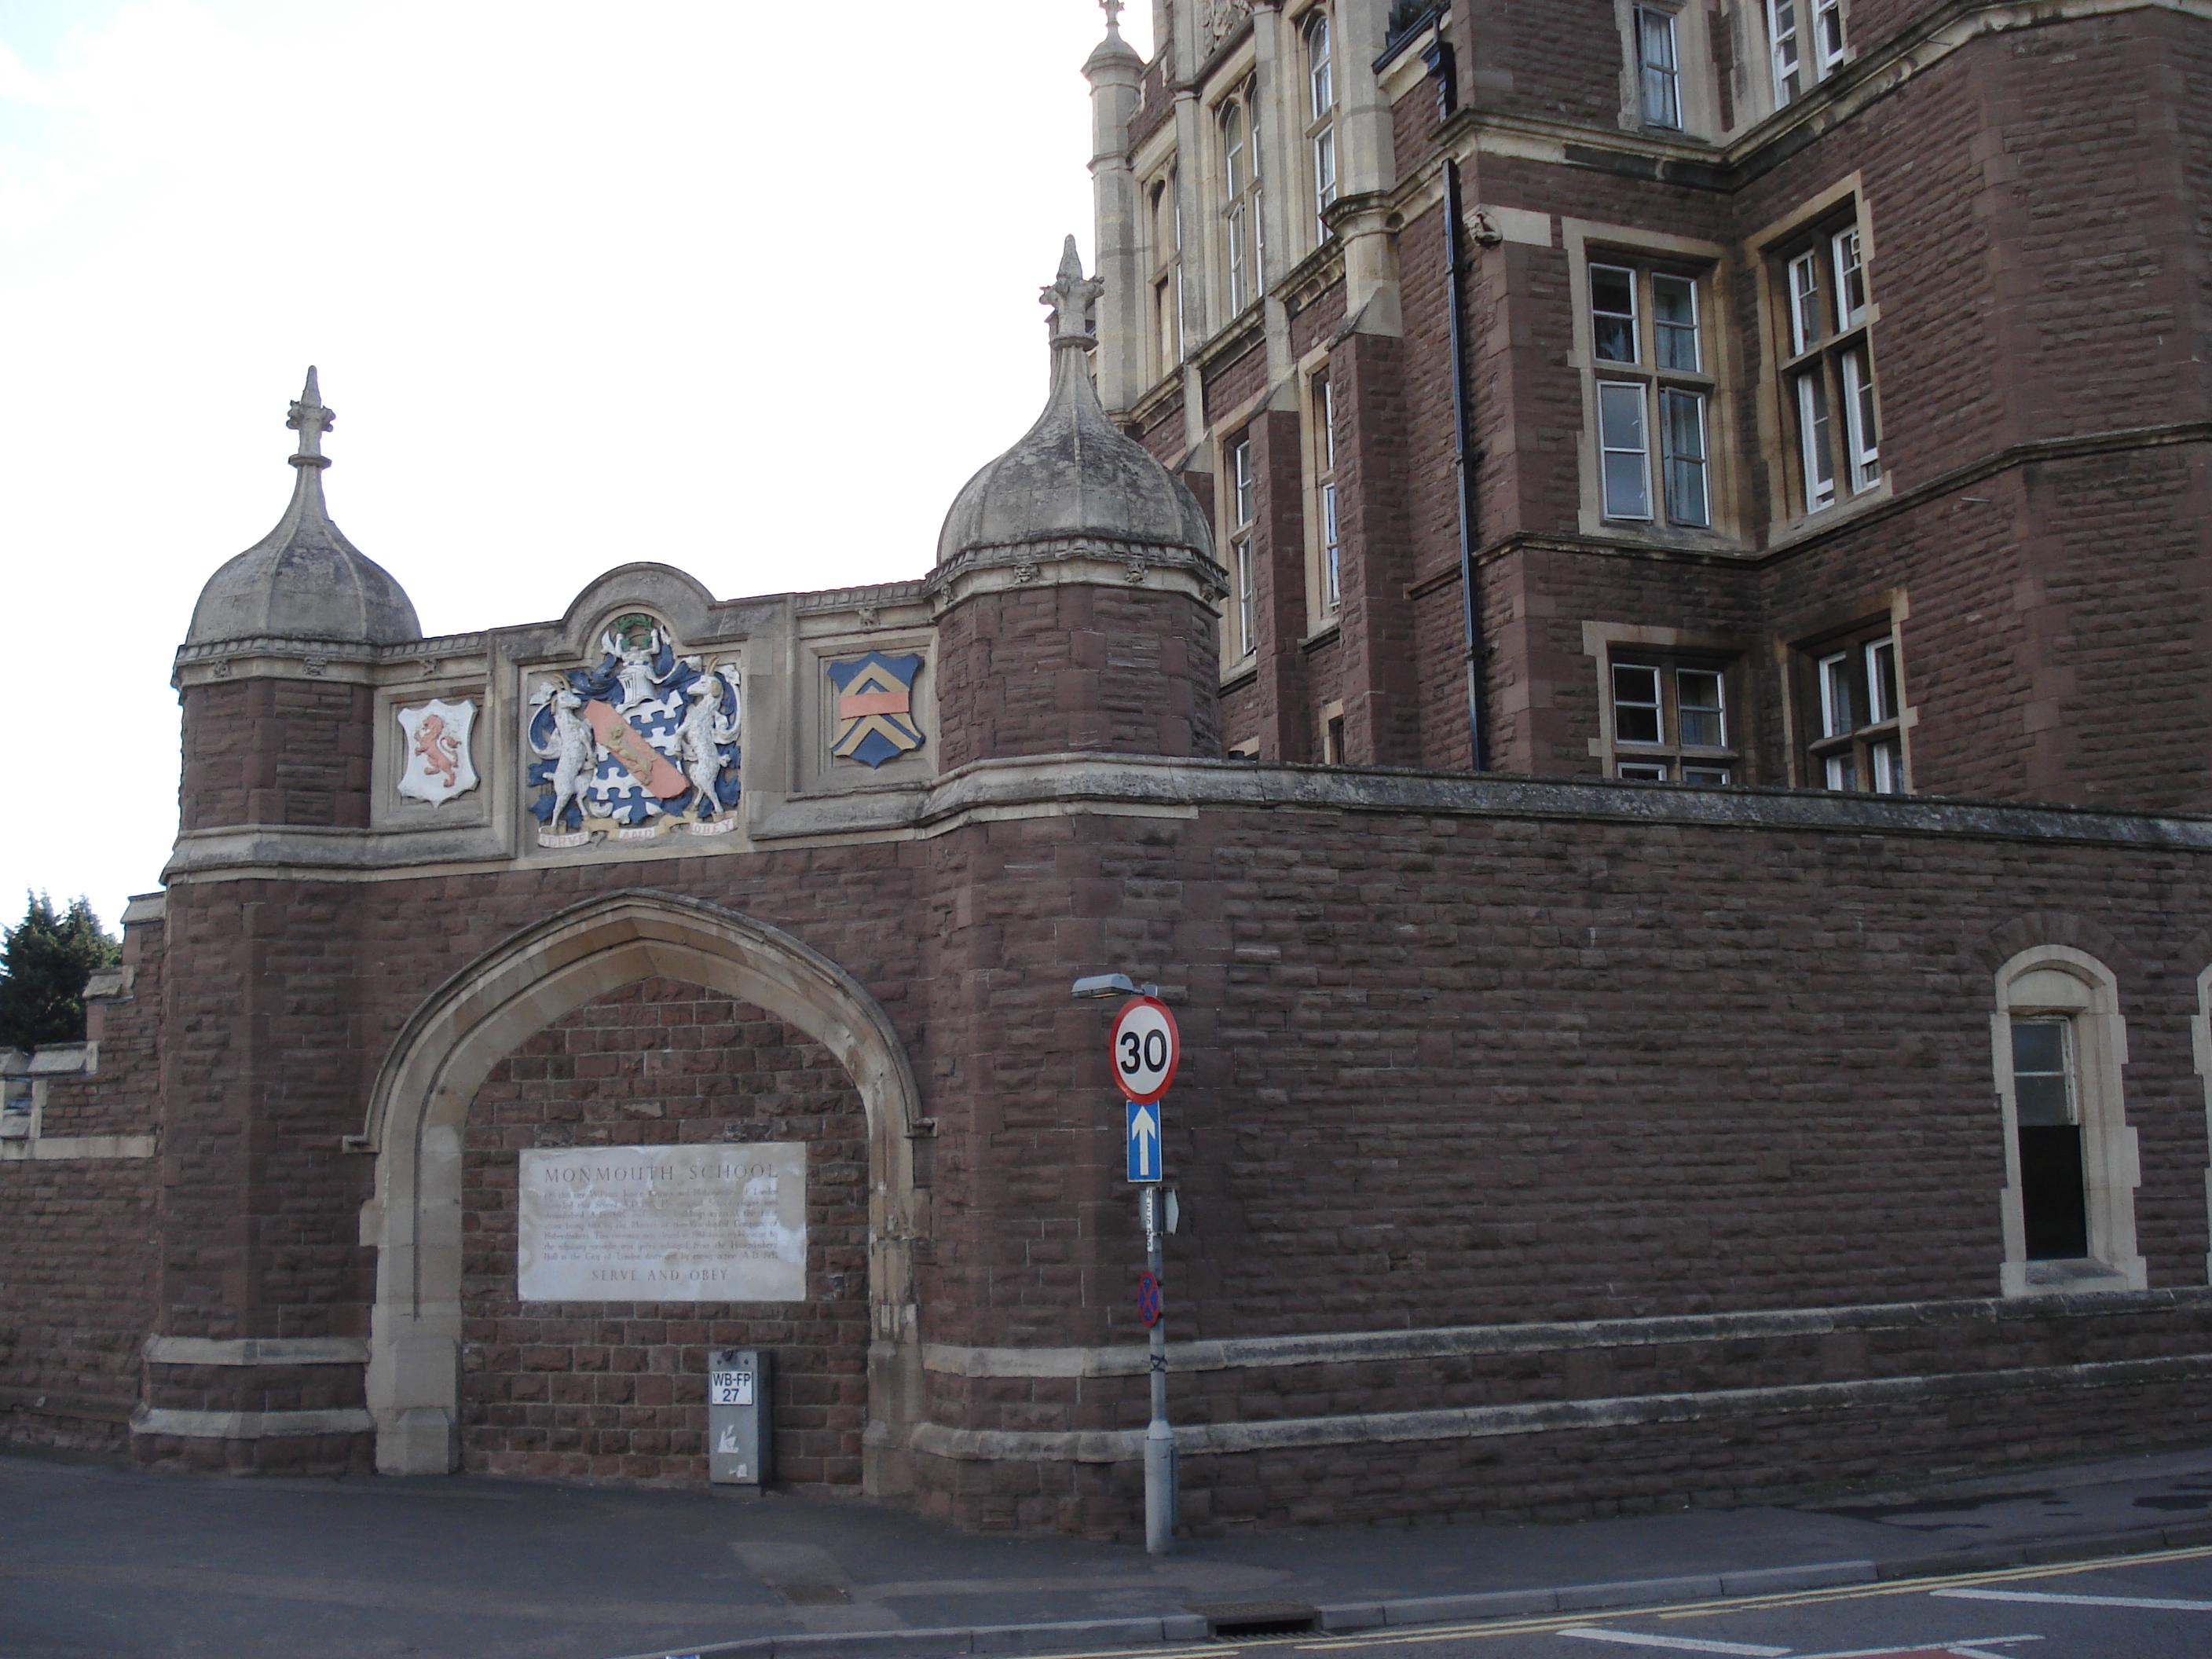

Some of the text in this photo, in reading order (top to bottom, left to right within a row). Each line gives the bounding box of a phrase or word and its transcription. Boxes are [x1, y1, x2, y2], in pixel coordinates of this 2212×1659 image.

[540, 821, 732, 848] SERVE AND OBEY
[1120, 1029, 1167, 1075] 30
[544, 1163, 778, 1183] MONMOUTH SCHOOL
[591, 1269, 730, 1282] SERVE AND OBEY
[713, 1373, 751, 1386] WB-FP
[723, 1388, 739, 1402] 27
